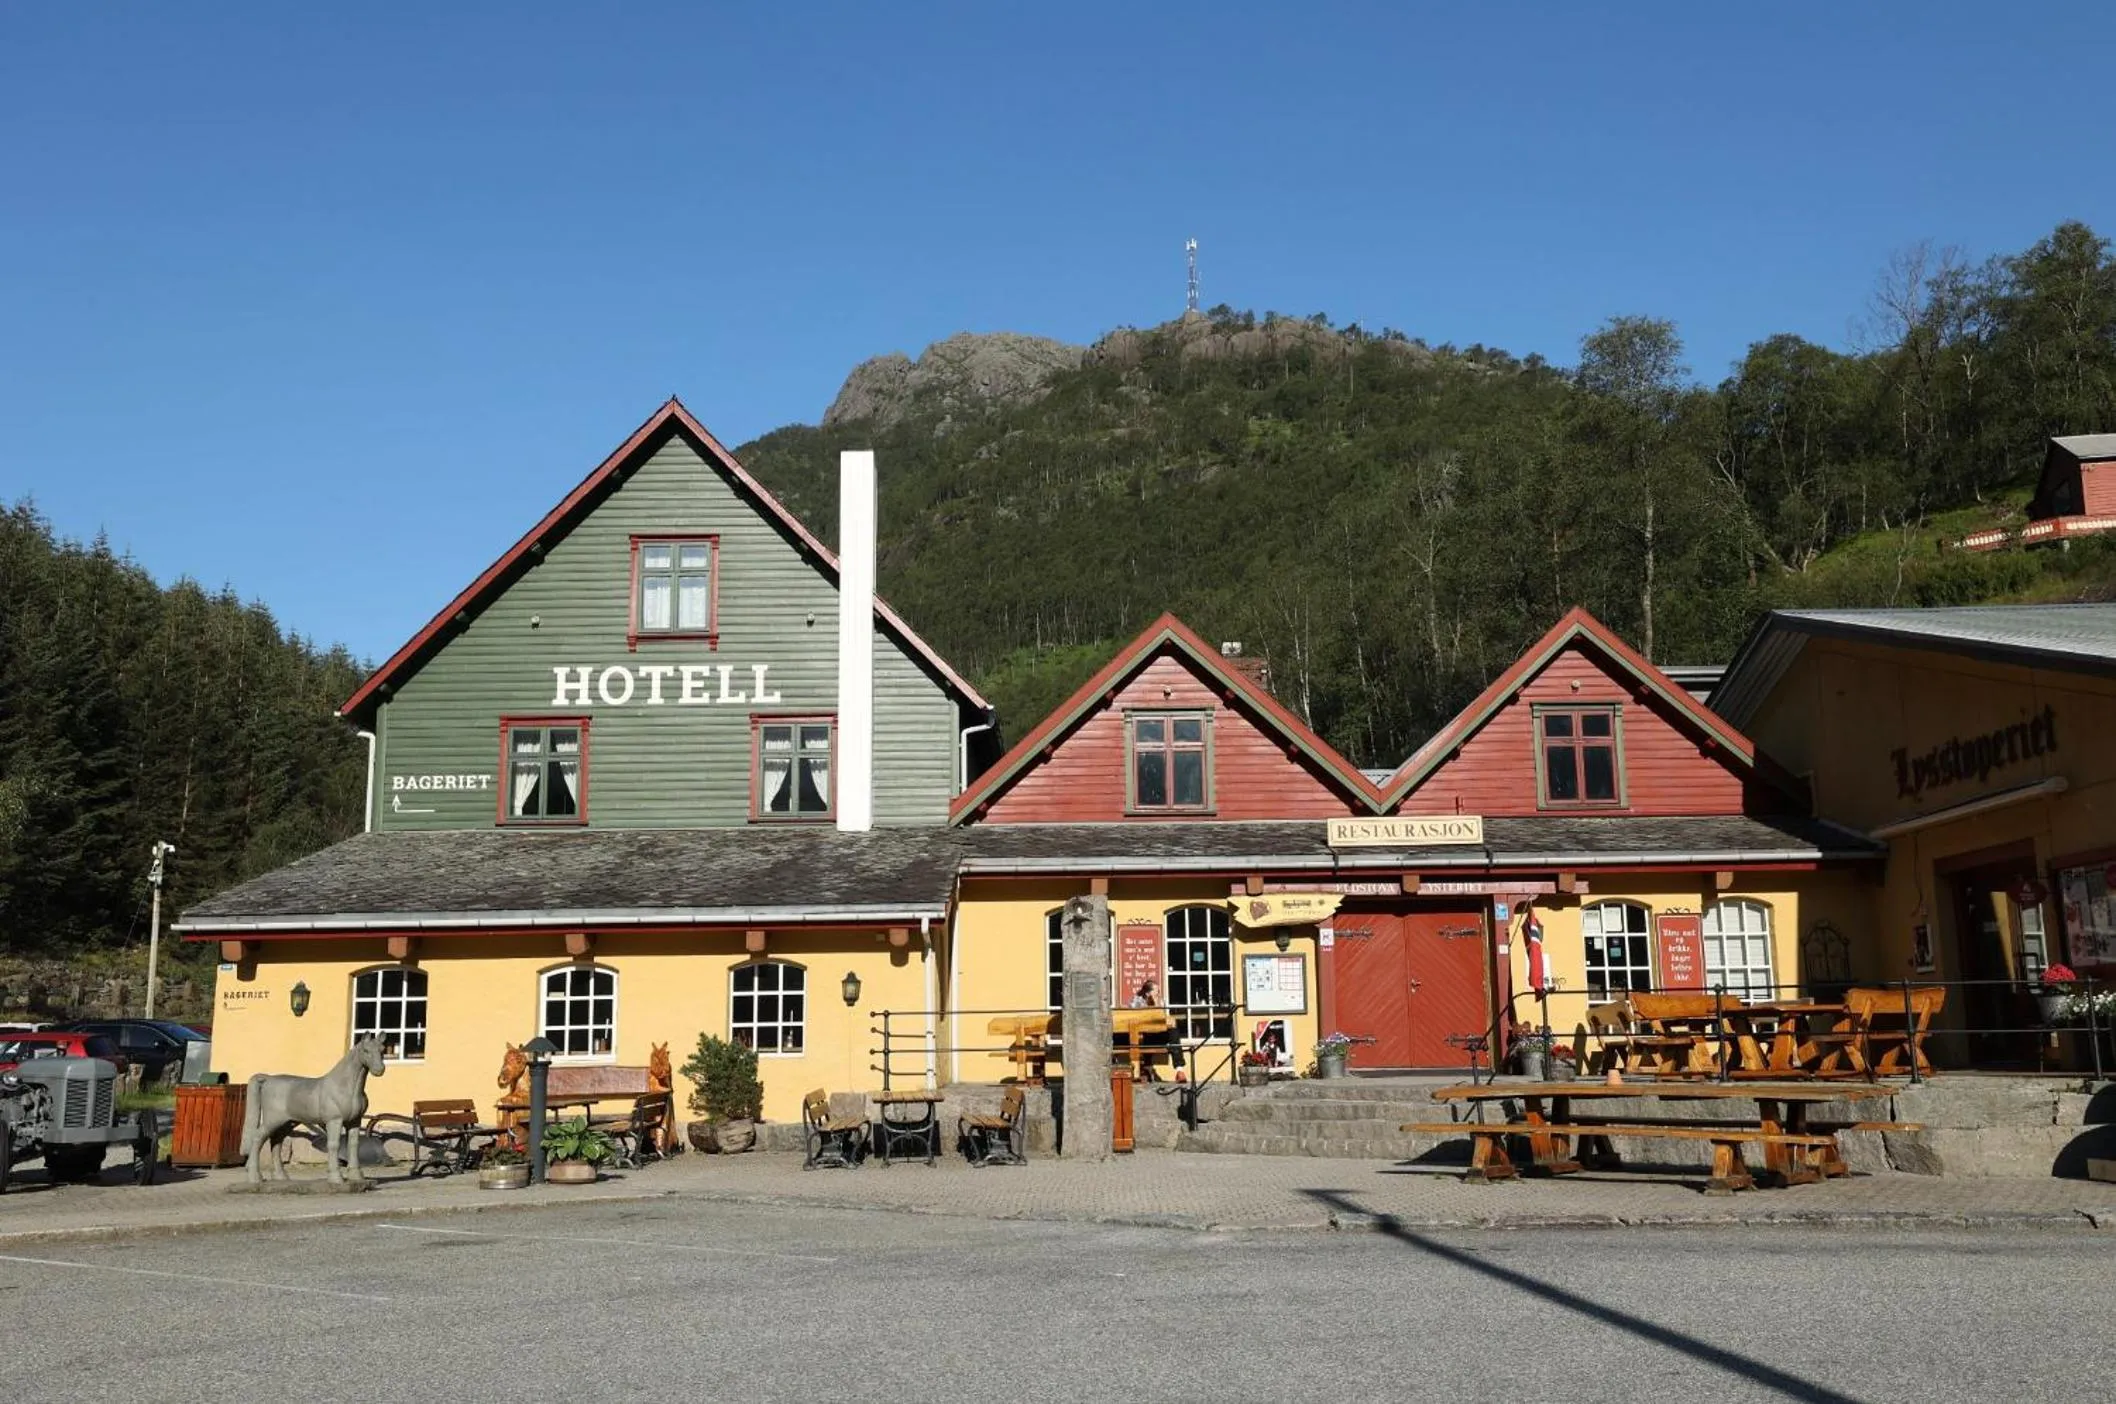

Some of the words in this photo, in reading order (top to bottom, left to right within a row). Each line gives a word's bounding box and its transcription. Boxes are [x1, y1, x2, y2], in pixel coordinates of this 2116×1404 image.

[551, 664, 781, 706] HOTELL
[392, 775, 491, 790] BAGERIET
[1337, 822, 1476, 839] RESTAURASJON
[223, 991, 270, 1000] BAGERIET
